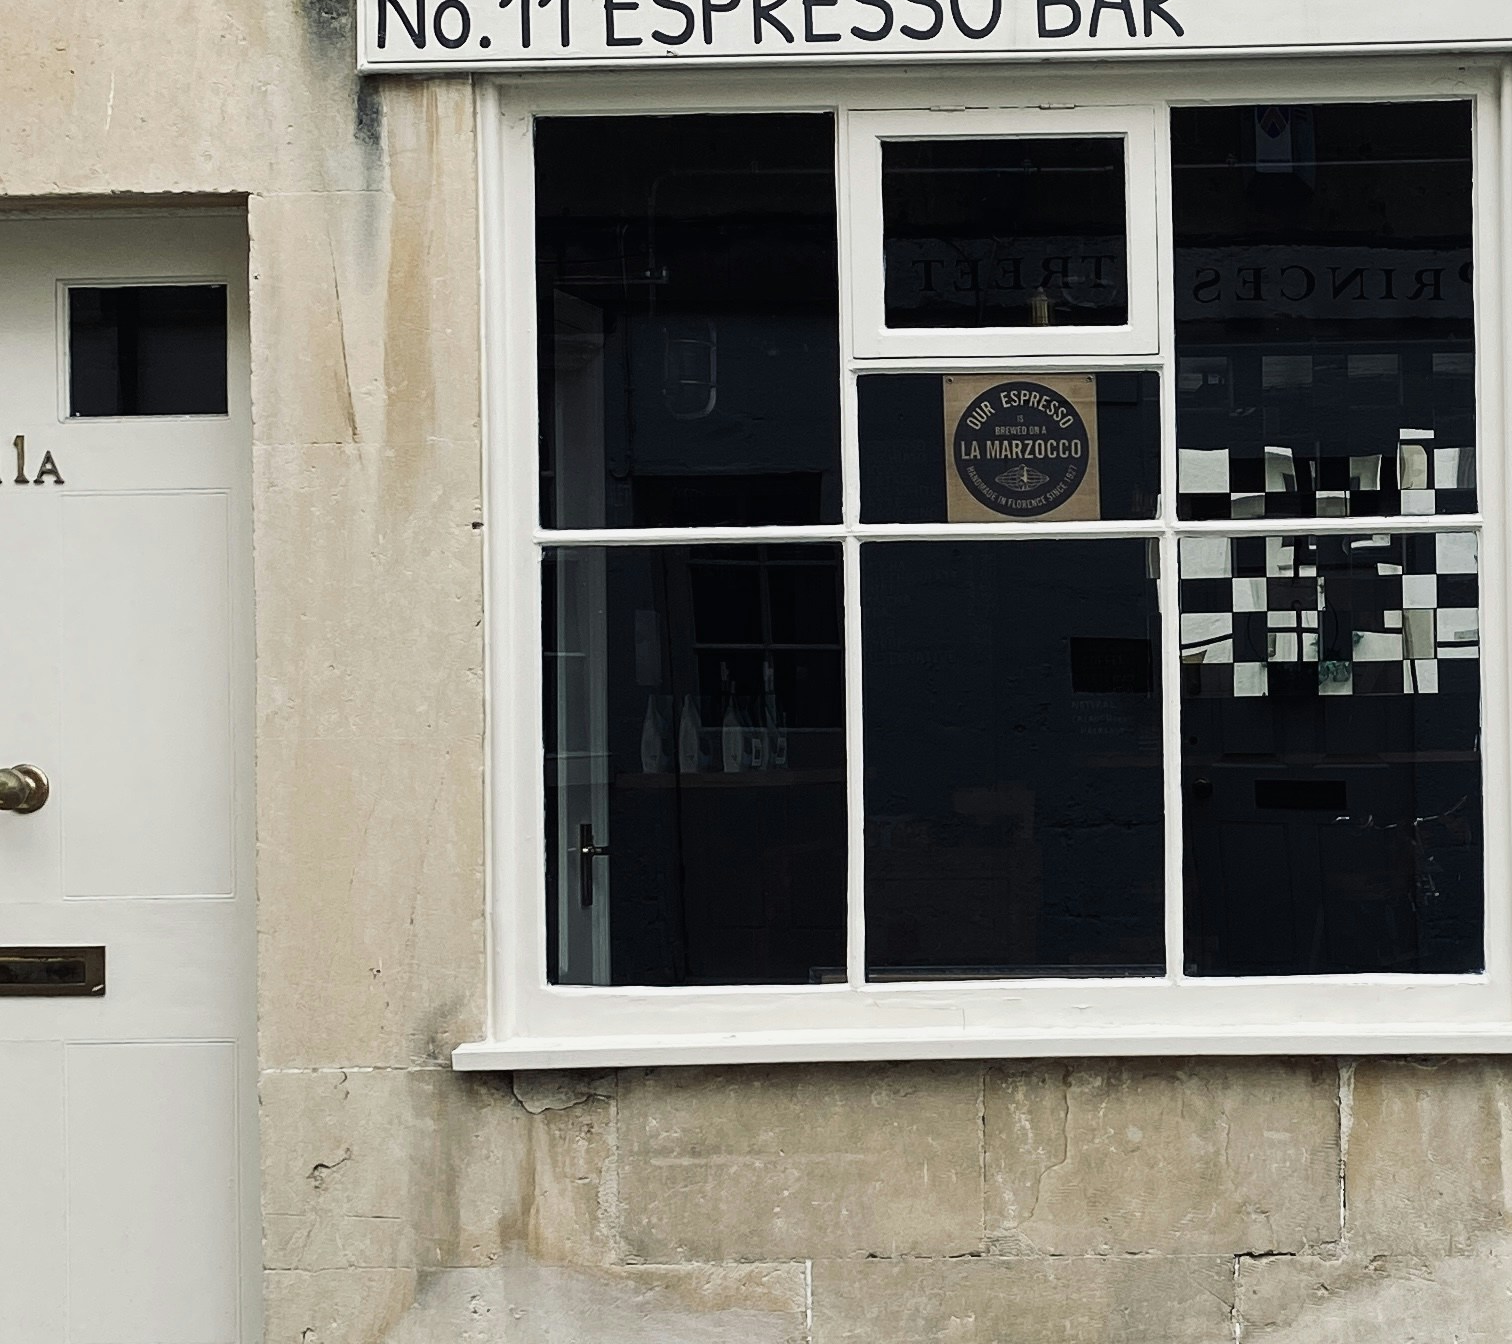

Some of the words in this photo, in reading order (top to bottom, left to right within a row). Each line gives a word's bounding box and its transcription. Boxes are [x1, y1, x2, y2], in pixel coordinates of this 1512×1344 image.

[967, 401, 996, 430] OUR
[1000, 390, 1074, 428] ESPRESSO
[960, 441, 980, 459] LA
[986, 439, 1081, 459] MARZOCCO
[995, 426, 1027, 435] BREWED
[1029, 426, 1039, 435] ON
[1041, 426, 1047, 434] A
[0, 435, 65, 484] 1A
[966, 466, 997, 501] HANDMADE
[999, 495, 1007, 506] IN
[1008, 494, 1047, 509] FLORENCE
[1048, 482, 1068, 501] SINCE
